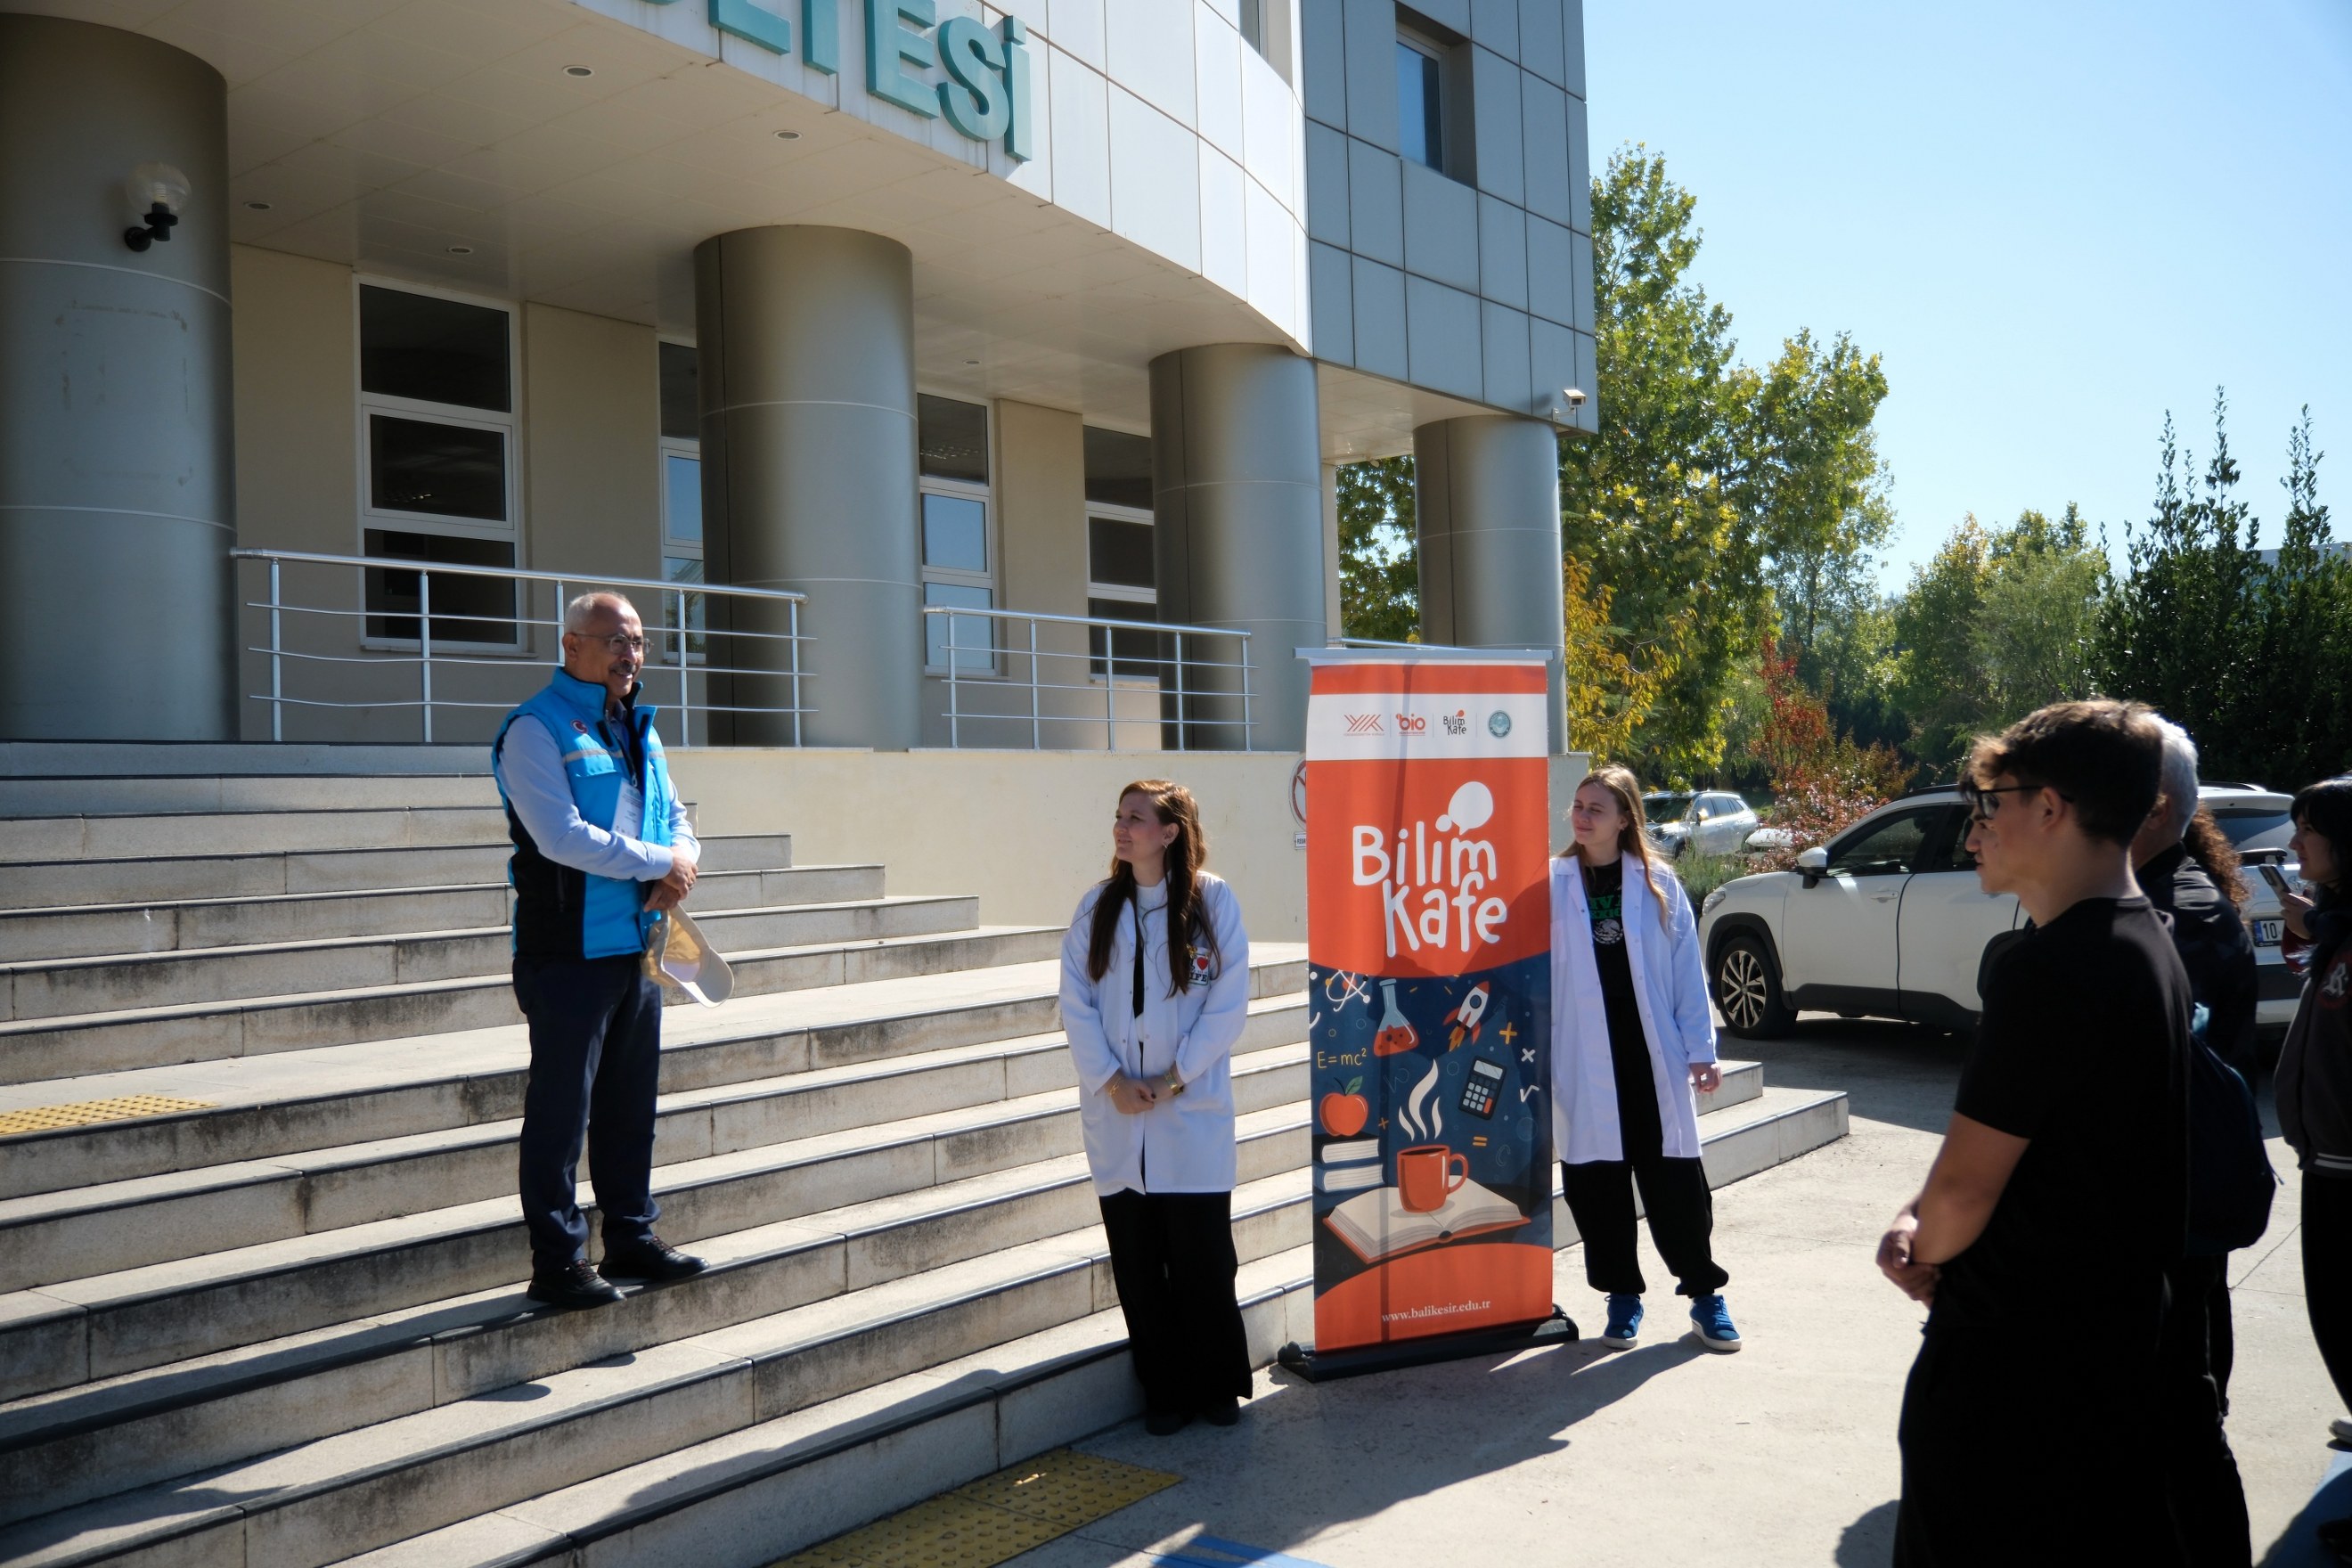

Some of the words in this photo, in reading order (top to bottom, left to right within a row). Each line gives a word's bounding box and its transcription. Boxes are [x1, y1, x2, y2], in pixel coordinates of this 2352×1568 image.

[1396, 714, 1425, 731] bio
[1443, 714, 1465, 725] Bilim
[1447, 723, 1466, 735] Kafe
[1352, 820, 1497, 887] Bilim
[1383, 870, 1507, 958] Kafe
[2263, 922, 2277, 940] 10
[1382, 1300, 1490, 1322] www.balikesir.edu.tr
